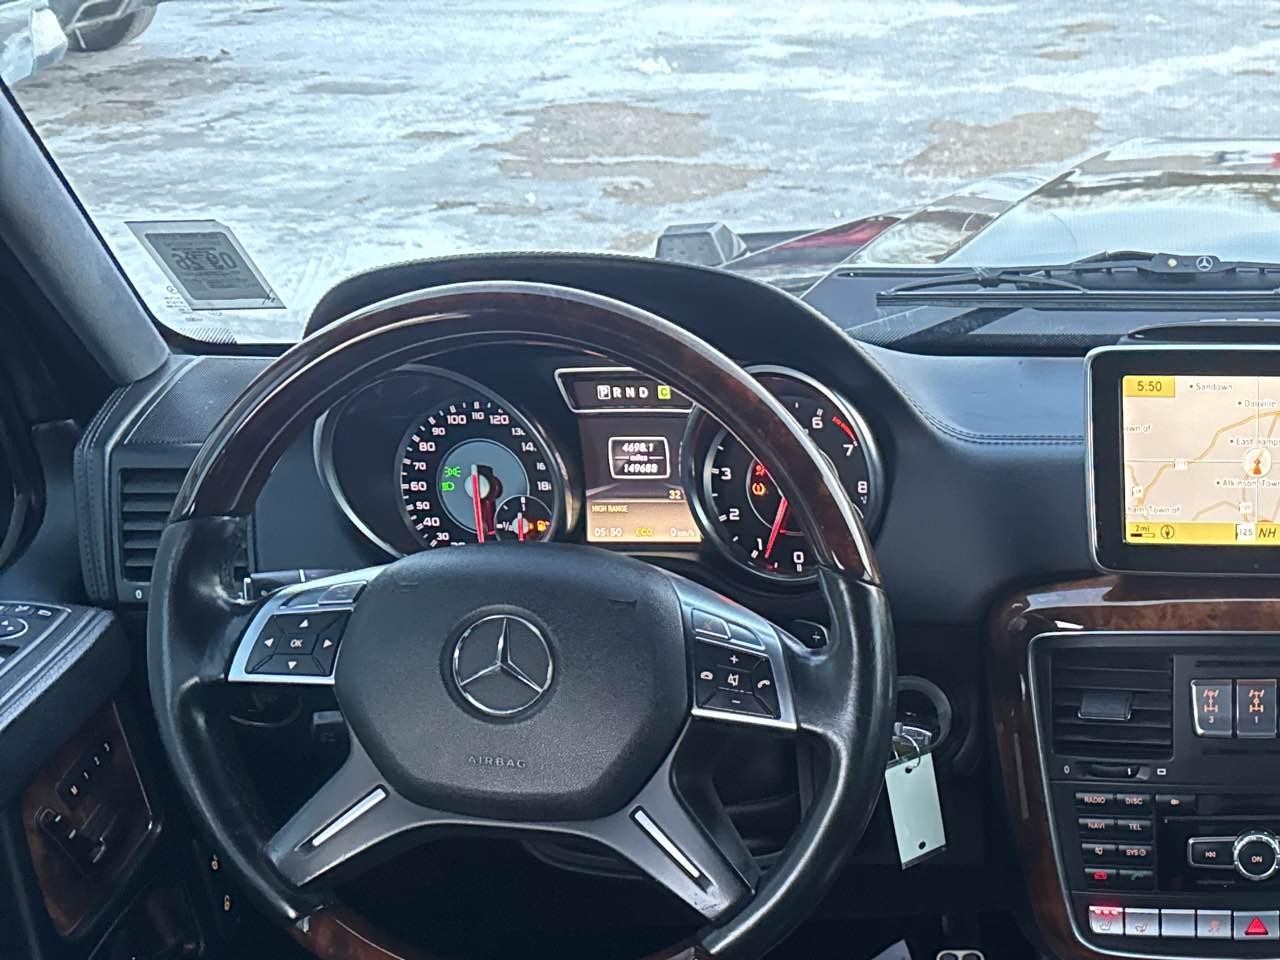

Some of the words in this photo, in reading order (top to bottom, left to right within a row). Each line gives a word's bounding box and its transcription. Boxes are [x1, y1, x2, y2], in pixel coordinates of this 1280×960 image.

[1137, 381, 1162, 392] 5:50
[600, 388, 610, 398] P
[613, 387, 622, 398] R
[626, 387, 635, 398] N
[639, 387, 649, 398] D
[447, 415, 467, 425] 100
[471, 411, 485, 420] 110
[489, 415, 510, 425] 120
[812, 416, 823, 429] 6
[431, 427, 446, 435] 90
[418, 442, 436, 452] 80
[521, 441, 537, 452] 14
[843, 444, 854, 457] 7
[412, 462, 427, 470] 70
[721, 467, 732, 480] 3
[410, 481, 427, 491] 60
[858, 480, 868, 493] 8
[669, 490, 682, 499] 32
[415, 501, 430, 510] 50
[591, 504, 607, 513] HIGH
[608, 504, 629, 513] RANGE
[729, 508, 740, 520] 2
[422, 517, 440, 527] 40
[436, 532, 450, 541] 30
[594, 527, 623, 537] 05:50
[635, 527, 654, 537] ECO
[1239, 528, 1253, 536] 125
[1258, 528, 1277, 538] NH
[756, 537, 763, 550] 1
[793, 551, 804, 564] 0
[290, 639, 303, 648] OK
[1208, 715, 1214, 724] 3
[1254, 715, 1259, 724] 1
[468, 755, 527, 769] AIRBAG
[1084, 796, 1106, 804] RADIO
[1125, 797, 1143, 805] DISC
[1128, 823, 1142, 831] TEL
